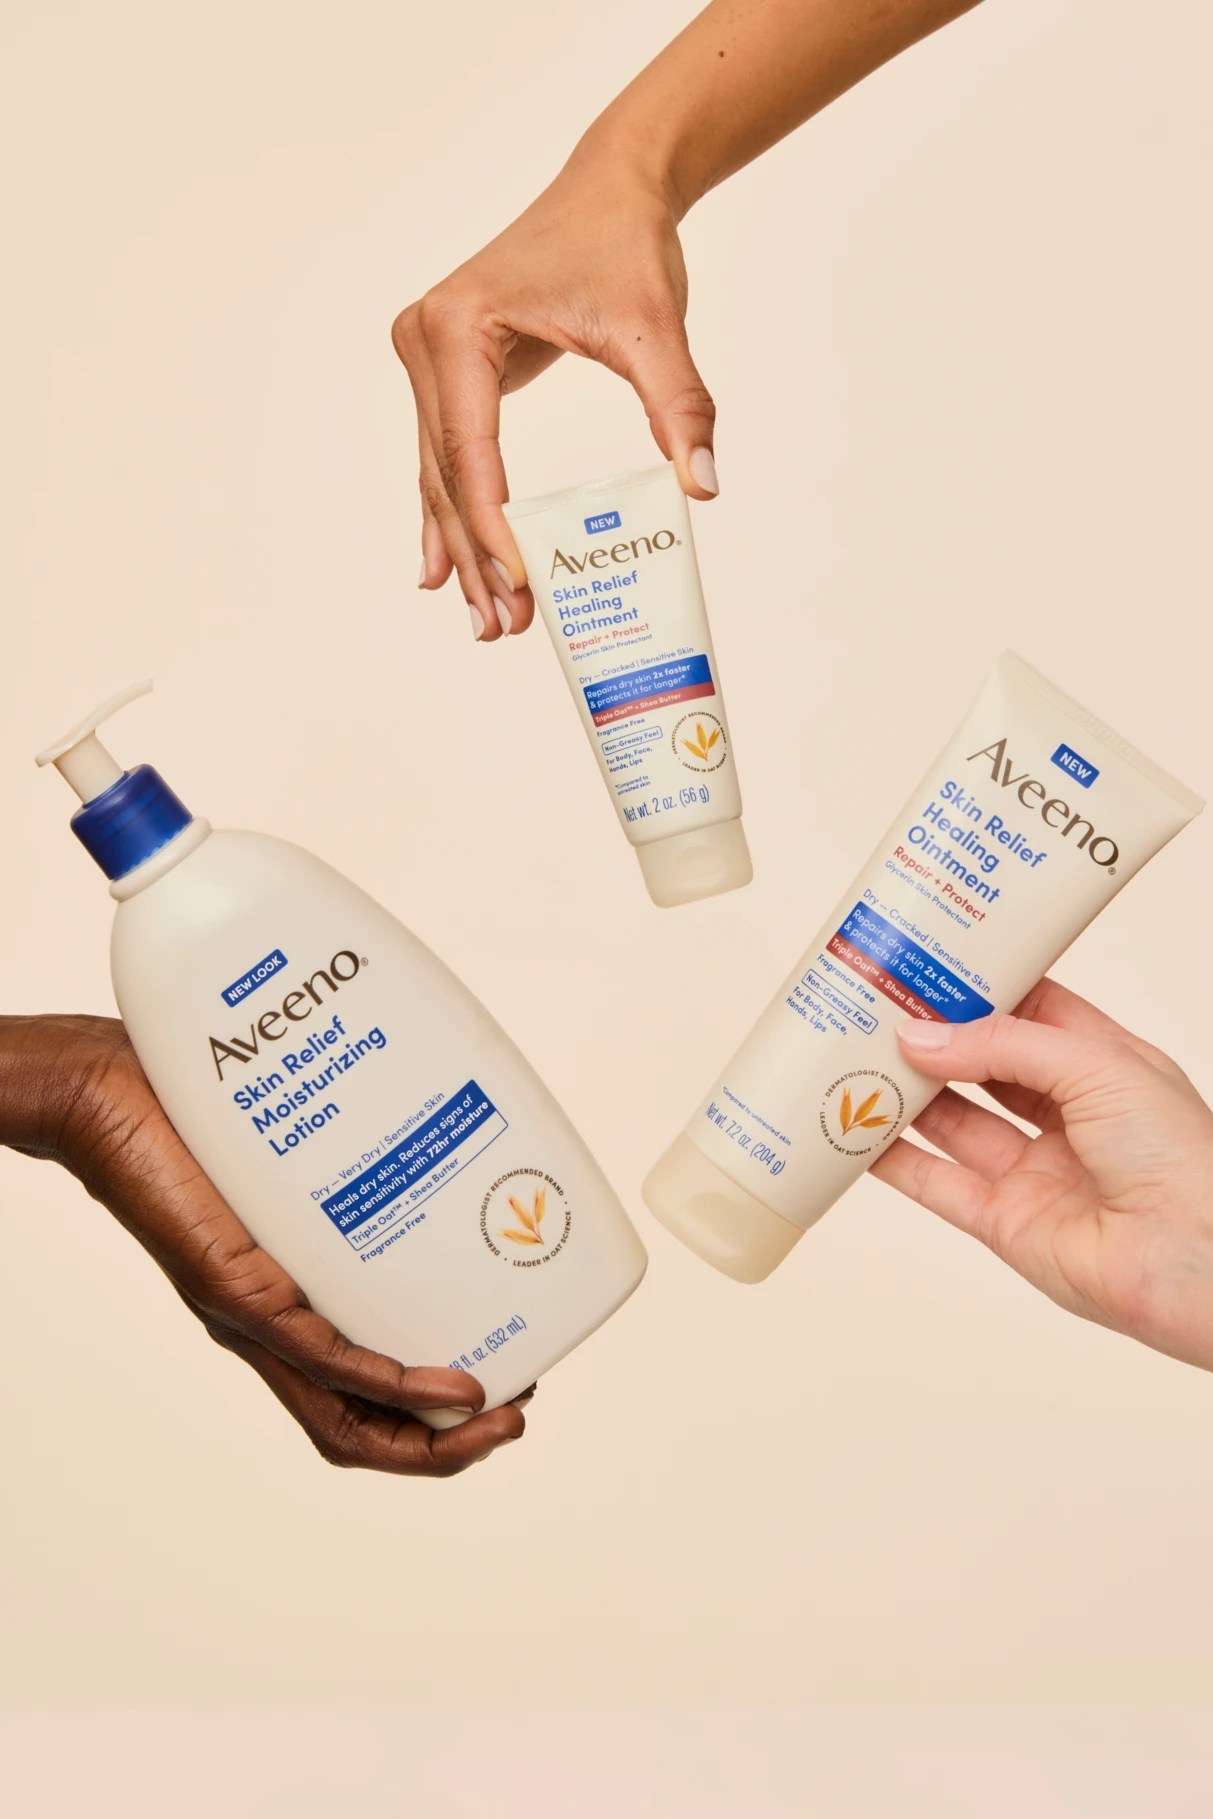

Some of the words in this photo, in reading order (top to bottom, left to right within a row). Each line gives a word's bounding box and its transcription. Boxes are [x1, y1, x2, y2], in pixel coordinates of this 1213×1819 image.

[590, 515, 615, 530] NEW
[553, 586, 588, 603] Skin
[591, 570, 637, 594] Relief
[558, 596, 622, 620] Healing
[562, 607, 638, 637] Ointment
[568, 636, 602, 652] Repair
[612, 623, 649, 639] Protect
[572, 649, 600, 662] Glycerin
[616, 634, 652, 648] Protectant
[579, 676, 592, 685] Dry
[601, 661, 635, 676] Cracked
[640, 652, 676, 665] Sensitive
[677, 647, 694, 656] Skin
[587, 684, 618, 698] Repairs
[618, 680, 633, 689] dry
[635, 675, 652, 684] skin
[652, 671, 664, 679] 2x
[664, 663, 692, 677] faster
[590, 701, 596, 709] &
[597, 689, 632, 708] protects
[639, 685, 652, 693] for
[595, 713, 614, 722] Triple
[639, 700, 658, 709] Shea
[658, 694, 681, 704] Butter
[596, 724, 629, 738] Fragrance
[629, 718, 645, 726] Free
[604, 737, 643, 752] Non-Greasy
[644, 730, 659, 739] Feel
[608, 763, 628, 773] Hands,
[629, 758, 643, 766] Lips
[615, 753, 633, 762] Body,
[633, 747, 653, 756] Face,
[1059, 751, 1092, 780] NEW
[623, 806, 638, 823] Net
[636, 802, 652, 818] wt.
[652, 797, 661, 813] 2
[662, 796, 677, 810] oz.
[679, 787, 697, 808] (56
[699, 784, 710, 804] g)
[940, 781, 982, 823] Skin
[984, 815, 1047, 868] Relief
[921, 802, 1000, 873] Healing
[893, 845, 933, 879] Repair
[941, 883, 986, 922] Protect
[908, 826, 1000, 903] Ointment
[885, 860, 914, 886] Glycerin
[915, 883, 932, 899] Skin
[931, 895, 971, 930] Protectant
[842, 919, 855, 932] &
[850, 928, 890, 960] protects
[890, 956, 899, 966] it
[898, 963, 914, 978] for
[852, 909, 887, 940] Repairs
[887, 937, 907, 956] dry
[904, 952, 924, 970] skin
[924, 966, 937, 980] 2x
[937, 976, 967, 1002] faster
[863, 888, 879, 905] Dry
[889, 909, 930, 943] Cracked
[932, 942, 971, 978] Sensitive
[971, 974, 991, 993] Skin
[228, 978, 252, 1001] NEW
[251, 955, 282, 983] LOOK
[805, 975, 853, 1015] Non-Greasy
[853, 1011, 873, 1029] Feel
[817, 953, 855, 988] Fragrance
[856, 984, 875, 1003] Free
[831, 938, 854, 959] Triple
[884, 980, 906, 1001] Shea
[905, 997, 932, 1022] Butter
[786, 996, 807, 1019] Hands,
[809, 1015, 827, 1033] Lips
[793, 986, 804, 998] For
[803, 995, 824, 1017] Body,
[825, 1012, 847, 1035] Face,
[233, 1073, 284, 1110] Skin
[281, 1015, 346, 1075] Relief
[251, 1027, 387, 1135] Moisturizing
[825, 1069, 879, 1098] DERMATOLOGIST
[880, 1073, 904, 1119] RECOMMENDED
[268, 1103, 340, 1156] Lotion
[310, 1185, 330, 1201] Dry
[338, 1161, 362, 1179] Very
[361, 1147, 381, 1164] Dry
[384, 1110, 426, 1145] Sensitive
[424, 1093, 445, 1111] Skin
[706, 1101, 720, 1121] Net
[714, 1113, 727, 1129] wt.
[725, 1120, 742, 1140] 7.2
[738, 1134, 752, 1150] oz.
[750, 1142, 776, 1166] (204
[769, 1160, 786, 1176] g)
[745, 1107, 751, 1115] to
[751, 1113, 781, 1137] untreated
[779, 1135, 791, 1146] skin
[820, 1111, 830, 1138] LEADER
[827, 1137, 835, 1145] IN
[833, 1144, 846, 1154] OAT
[845, 1147, 871, 1156] SCIENCE
[328, 1193, 359, 1216] Heals
[359, 1178, 377, 1195] dry
[377, 1163, 401, 1181] skin.
[398, 1127, 440, 1163] Reduces
[439, 1106, 463, 1129] signs
[463, 1093, 473, 1108] of
[339, 1210, 360, 1227] skin
[359, 1173, 407, 1212] sensitivity
[406, 1156, 429, 1175] with
[426, 1136, 449, 1158] 72hr
[449, 1102, 488, 1139] moisture
[351, 1224, 378, 1243] Triple
[409, 1181, 433, 1201] Shea
[431, 1158, 458, 1183] Butter
[490, 1168, 543, 1192] RECOMMENDED
[544, 1174, 564, 1197] BRAND
[360, 1228, 406, 1263] Fragrance
[405, 1213, 426, 1230] Free
[480, 1192, 501, 1257] DERMATOLOGIST
[513, 1259, 542, 1268] LEADER
[542, 1255, 551, 1263] IN
[550, 1242, 563, 1257] OAT
[560, 1210, 571, 1244] SCIENCE
[460, 1354, 475, 1368] fl.
[472, 1347, 488, 1361] oz.
[484, 1328, 509, 1353] (532
[506, 1315, 527, 1336] mL)
